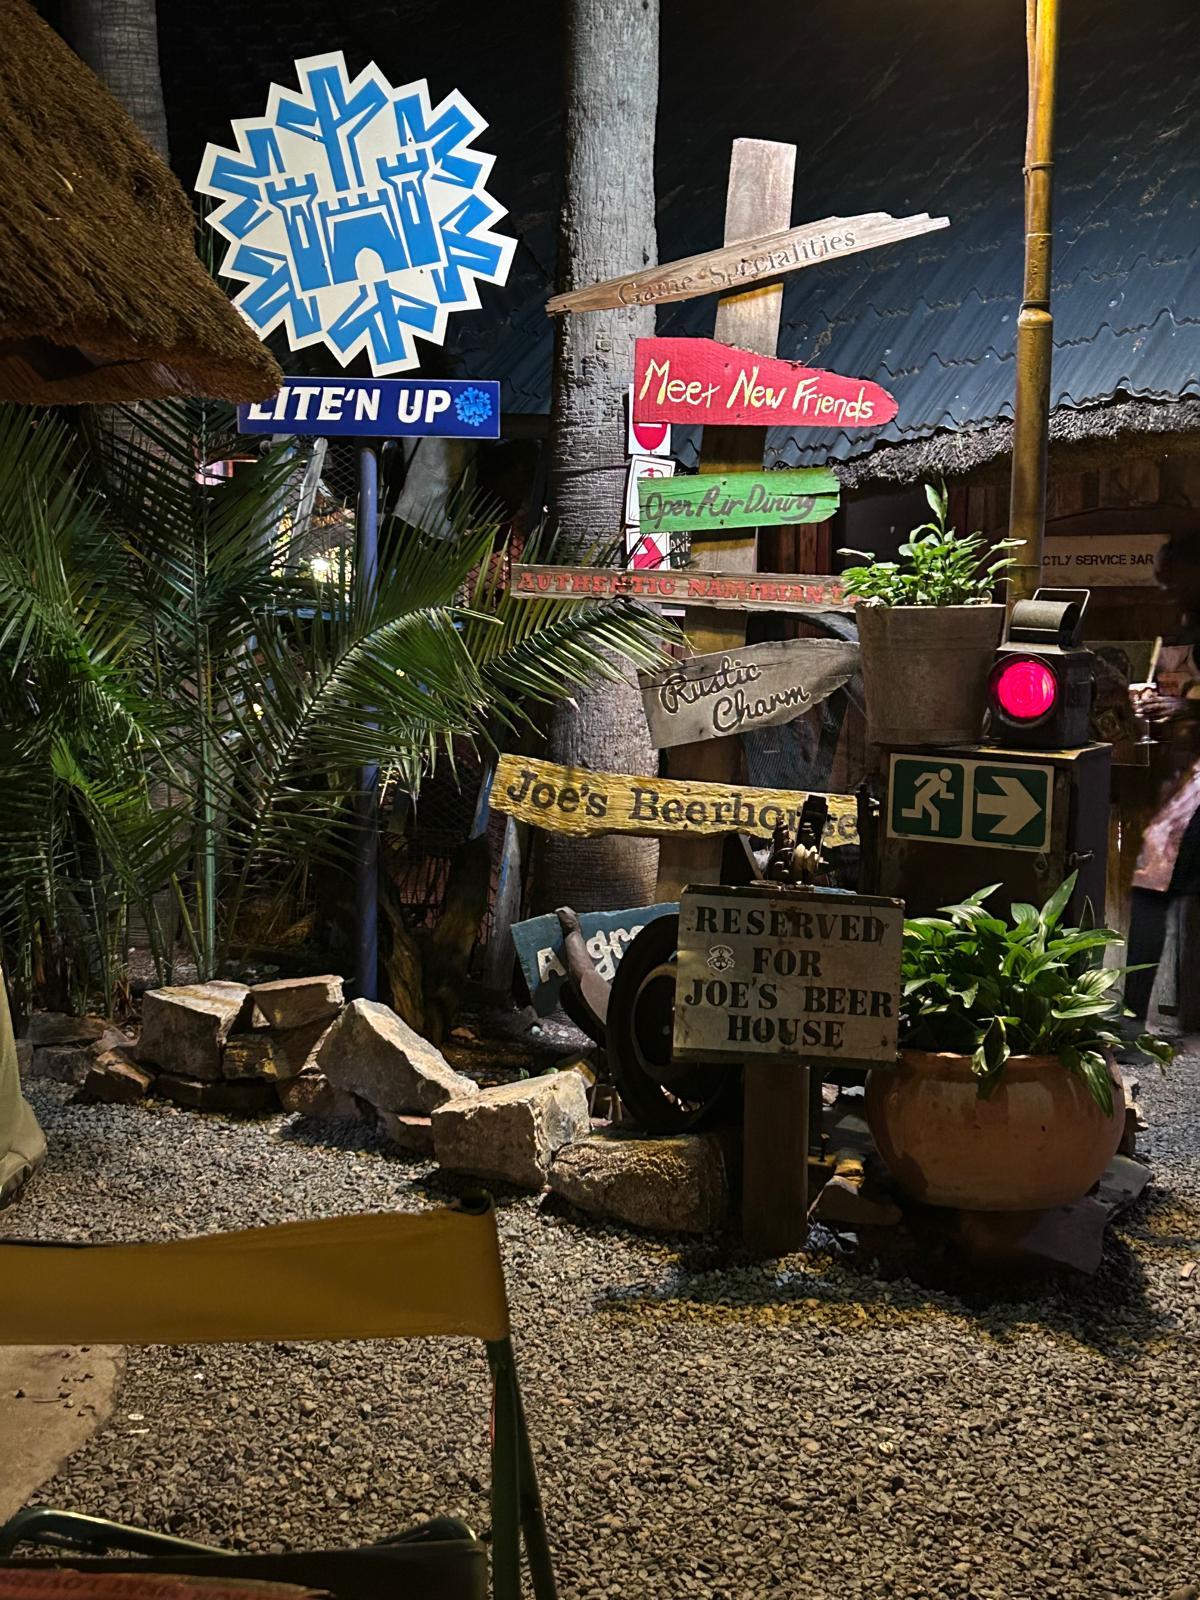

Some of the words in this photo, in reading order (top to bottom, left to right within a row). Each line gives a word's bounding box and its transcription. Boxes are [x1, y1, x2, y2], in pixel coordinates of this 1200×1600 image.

[617, 274, 694, 306] Game
[706, 230, 857, 280] Specialities
[398, 388, 451, 423] UP
[639, 358, 720, 409] Meet
[726, 366, 787, 409] New
[792, 376, 874, 423] Friends
[646, 491, 694, 529] Open
[695, 484, 745, 517] Air
[744, 484, 817, 522] Dining
[1075, 554, 1127, 566] SERVICE
[1130, 554, 1154, 566] BAR
[517, 572, 676, 596] AUTHENTIC
[688, 578, 825, 604] NAMIBIAN
[659, 656, 762, 715] Rustic
[713, 685, 811, 732] Charm
[506, 769, 608, 818] Joe's
[695, 906, 886, 943] RESERVED
[752, 948, 822, 978] FOR
[685, 978, 778, 1010] JOE'S
[803, 986, 893, 1018] BEER
[727, 1014, 845, 1048] HOUSE
